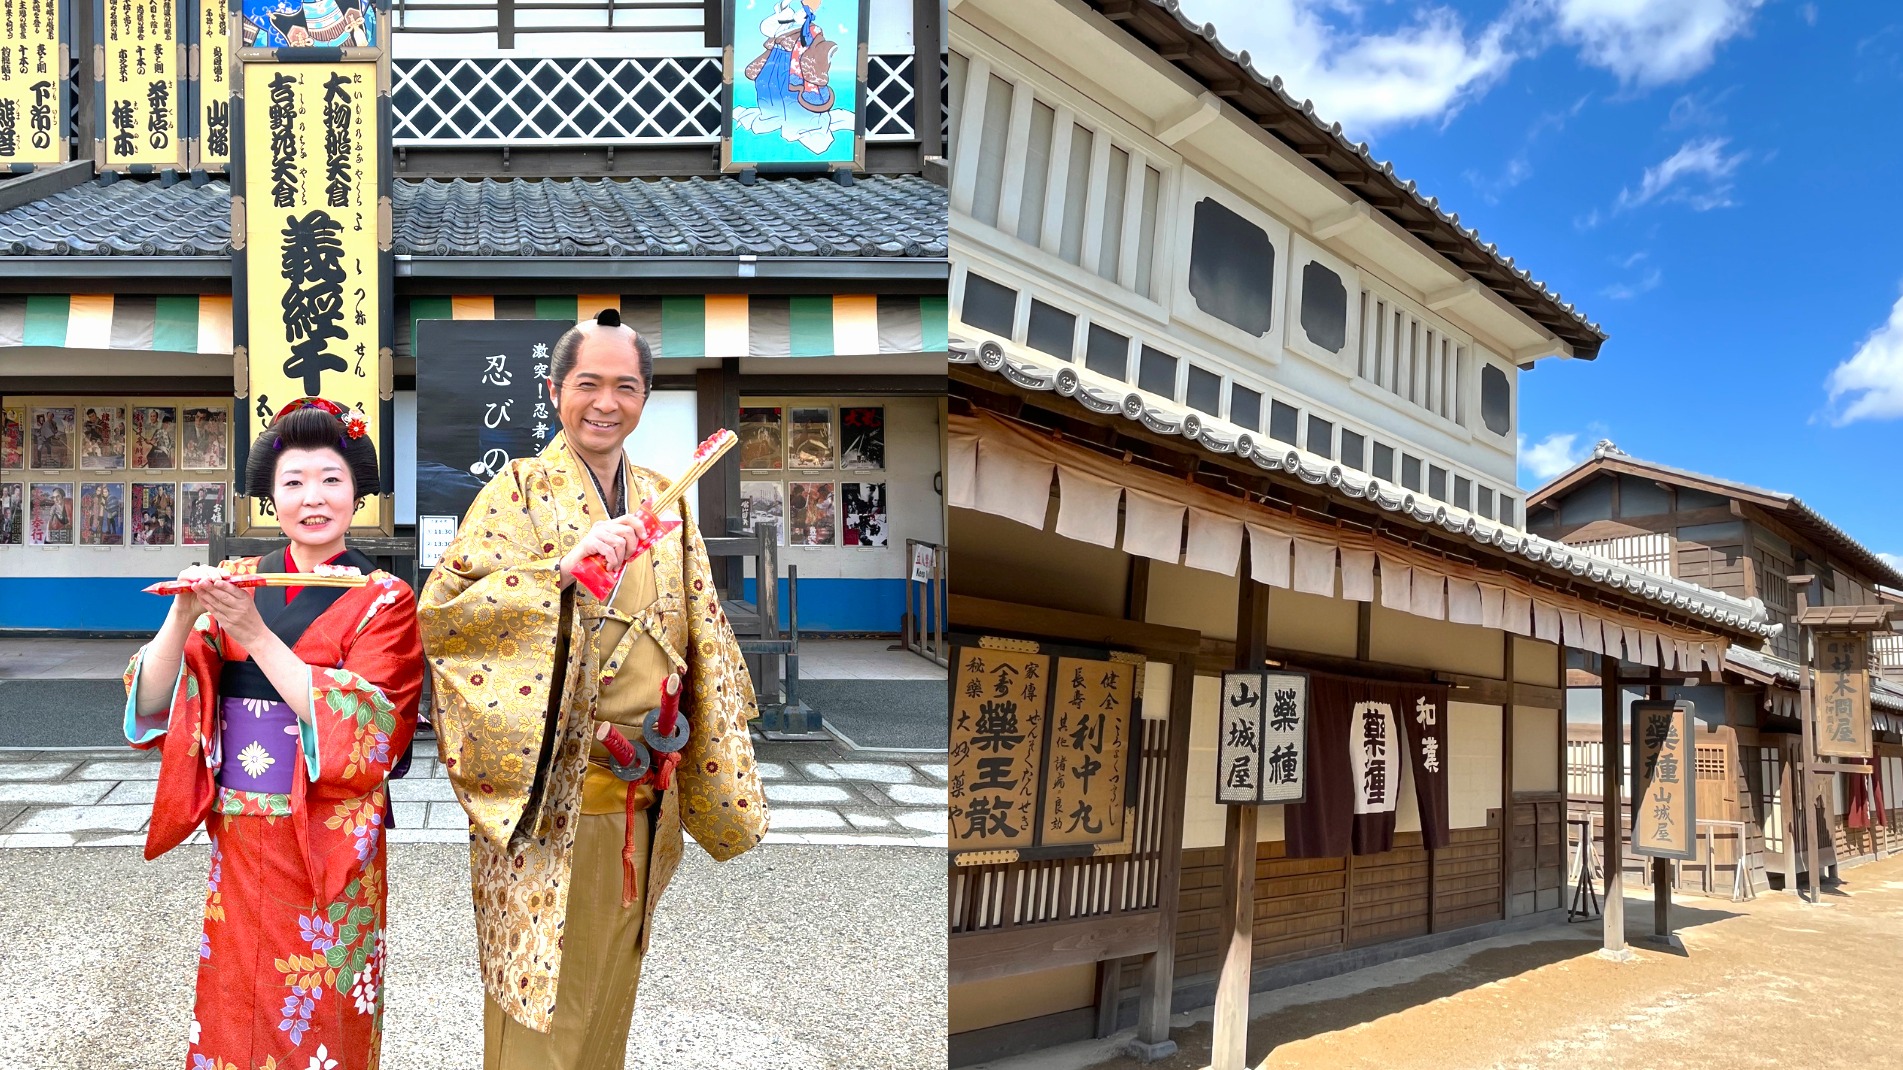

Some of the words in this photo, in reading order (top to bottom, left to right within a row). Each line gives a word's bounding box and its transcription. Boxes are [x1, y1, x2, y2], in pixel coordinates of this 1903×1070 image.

[1099, 672, 1120, 710] 健全
[1065, 713, 1104, 834] 利中丸
[1227, 682, 1260, 789] 山城屋
[1651, 787, 1674, 843] 山城屋
